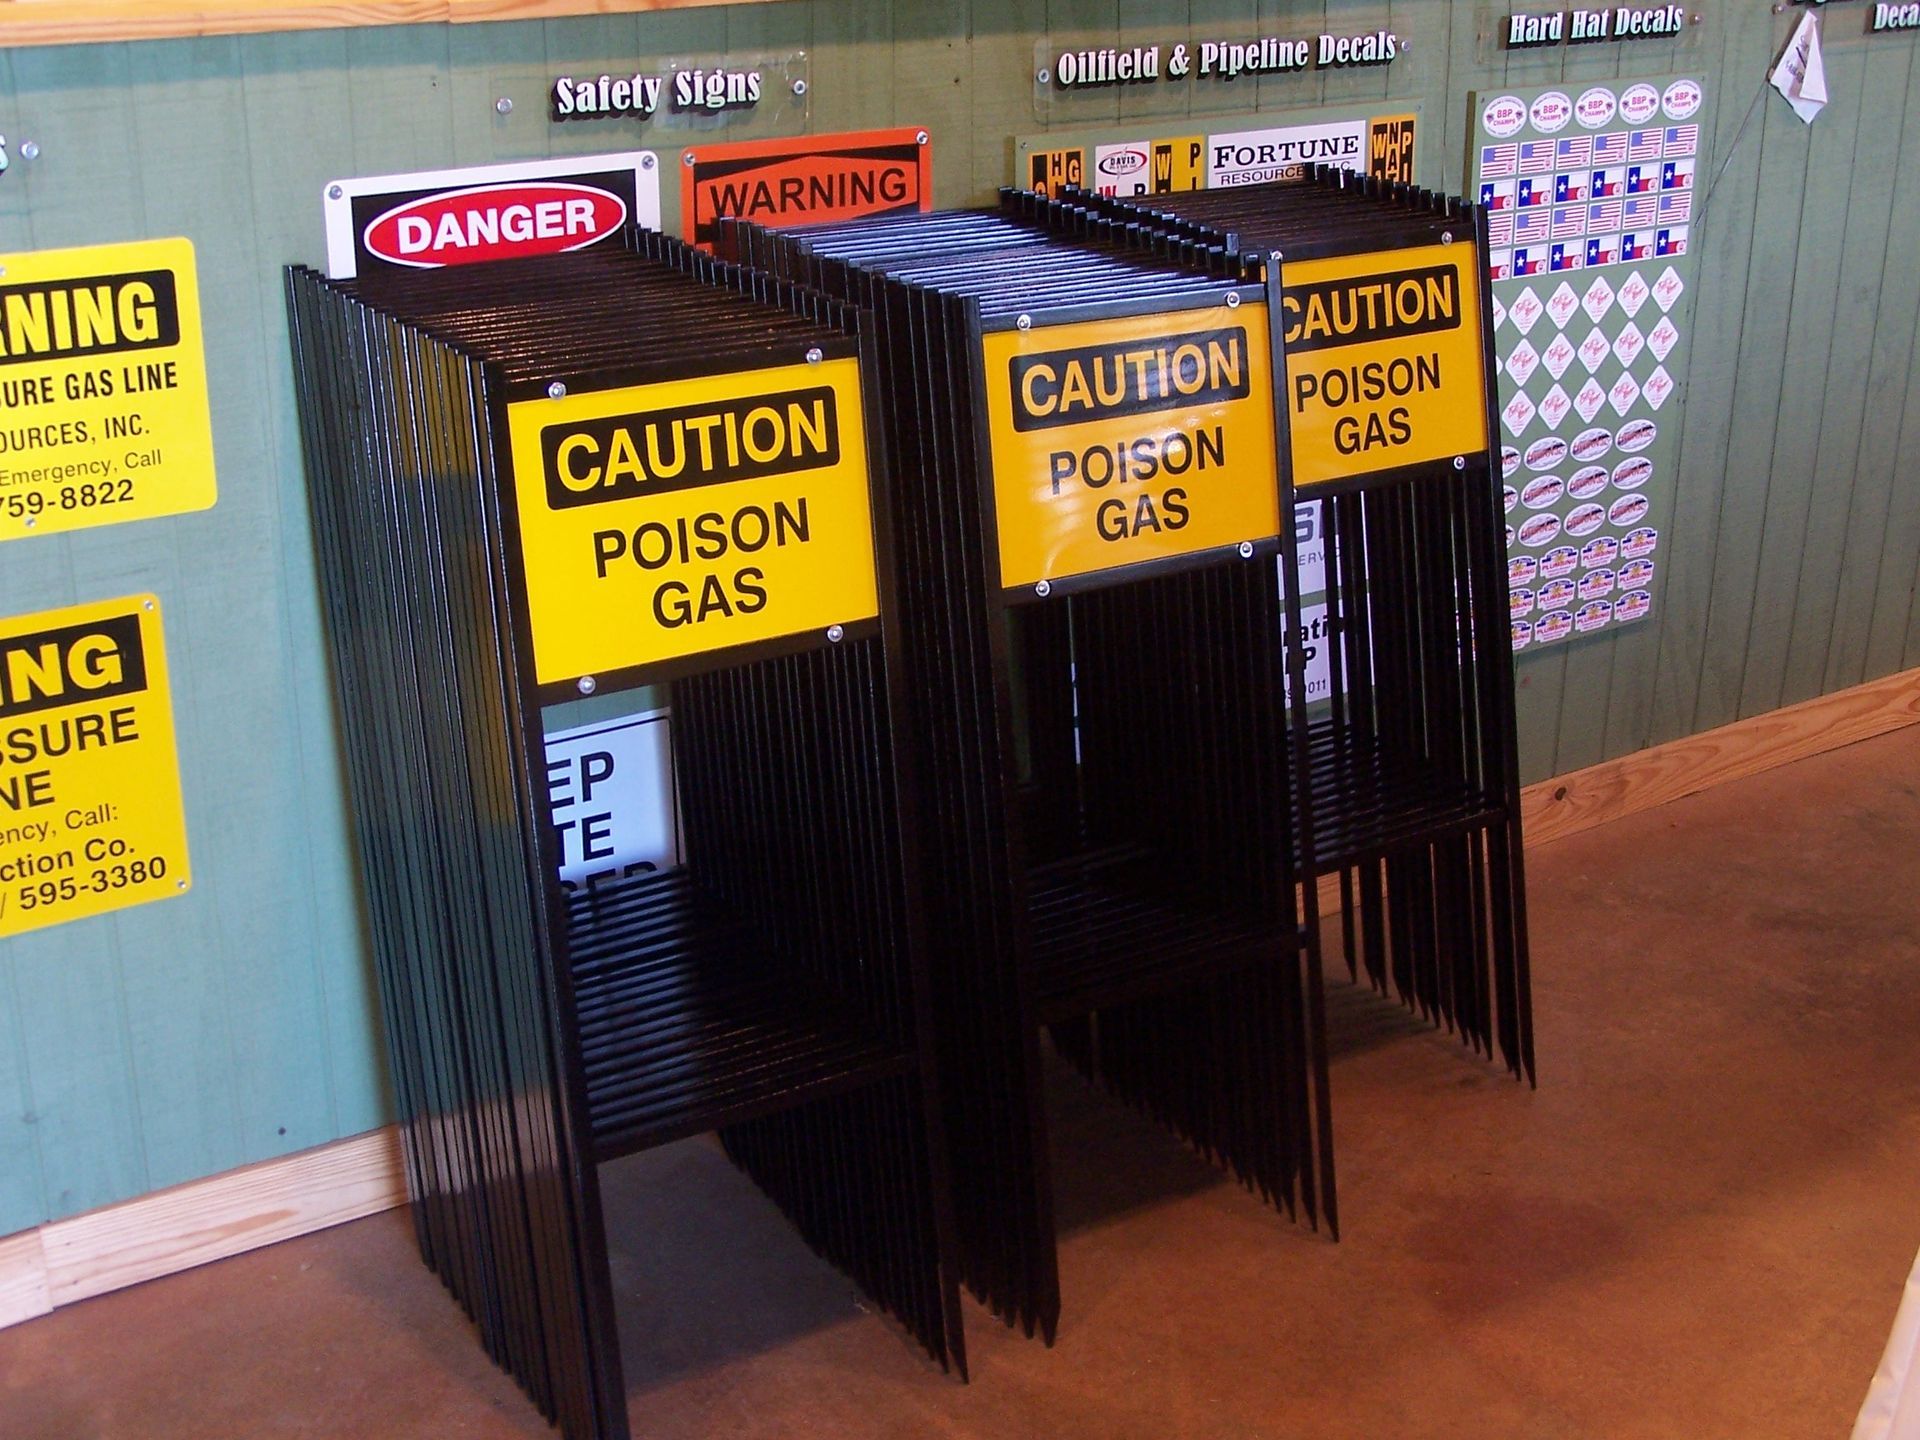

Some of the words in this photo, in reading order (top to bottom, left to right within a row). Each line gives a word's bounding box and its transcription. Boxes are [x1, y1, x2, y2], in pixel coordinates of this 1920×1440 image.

[1509, 12, 1564, 43] Hard
[1571, 9, 1608, 39] Hat
[1614, 5, 1684, 35] Decals
[1058, 46, 1159, 85] Oilfield
[1169, 44, 1189, 77] &
[1200, 37, 1309, 76] Pipeline
[1317, 31, 1396, 65] Decals
[556, 73, 661, 115] Safety
[676, 69, 761, 109] Signs
[1110, 156, 1136, 165] DAVIS
[1213, 136, 1359, 168] FORTUNE
[709, 167, 908, 217] WARNING
[397, 199, 597, 255] DANGER
[0, 281, 159, 356] NING
[1283, 275, 1453, 343] CAUTION
[0, 376, 55, 408] URE
[65, 369, 113, 400] GAS
[124, 361, 178, 393] LINE
[1021, 338, 1241, 417] CAUTION
[1295, 353, 1440, 413] POISON
[104, 413, 151, 440] INC.
[556, 399, 828, 492] CAUTION
[1334, 407, 1412, 455] GAS
[0, 457, 118, 486] Emergency,
[124, 448, 162, 470] Call
[1049, 426, 1226, 496] POISON
[593, 497, 810, 579] POISON
[1096, 487, 1189, 542] GAS
[652, 567, 768, 629] GAS
[0, 633, 123, 706] NG
[0, 706, 139, 766] SURE
[65, 803, 118, 830] Call:
[84, 837, 135, 862] Co.
[20, 855, 167, 910] 595-3380
